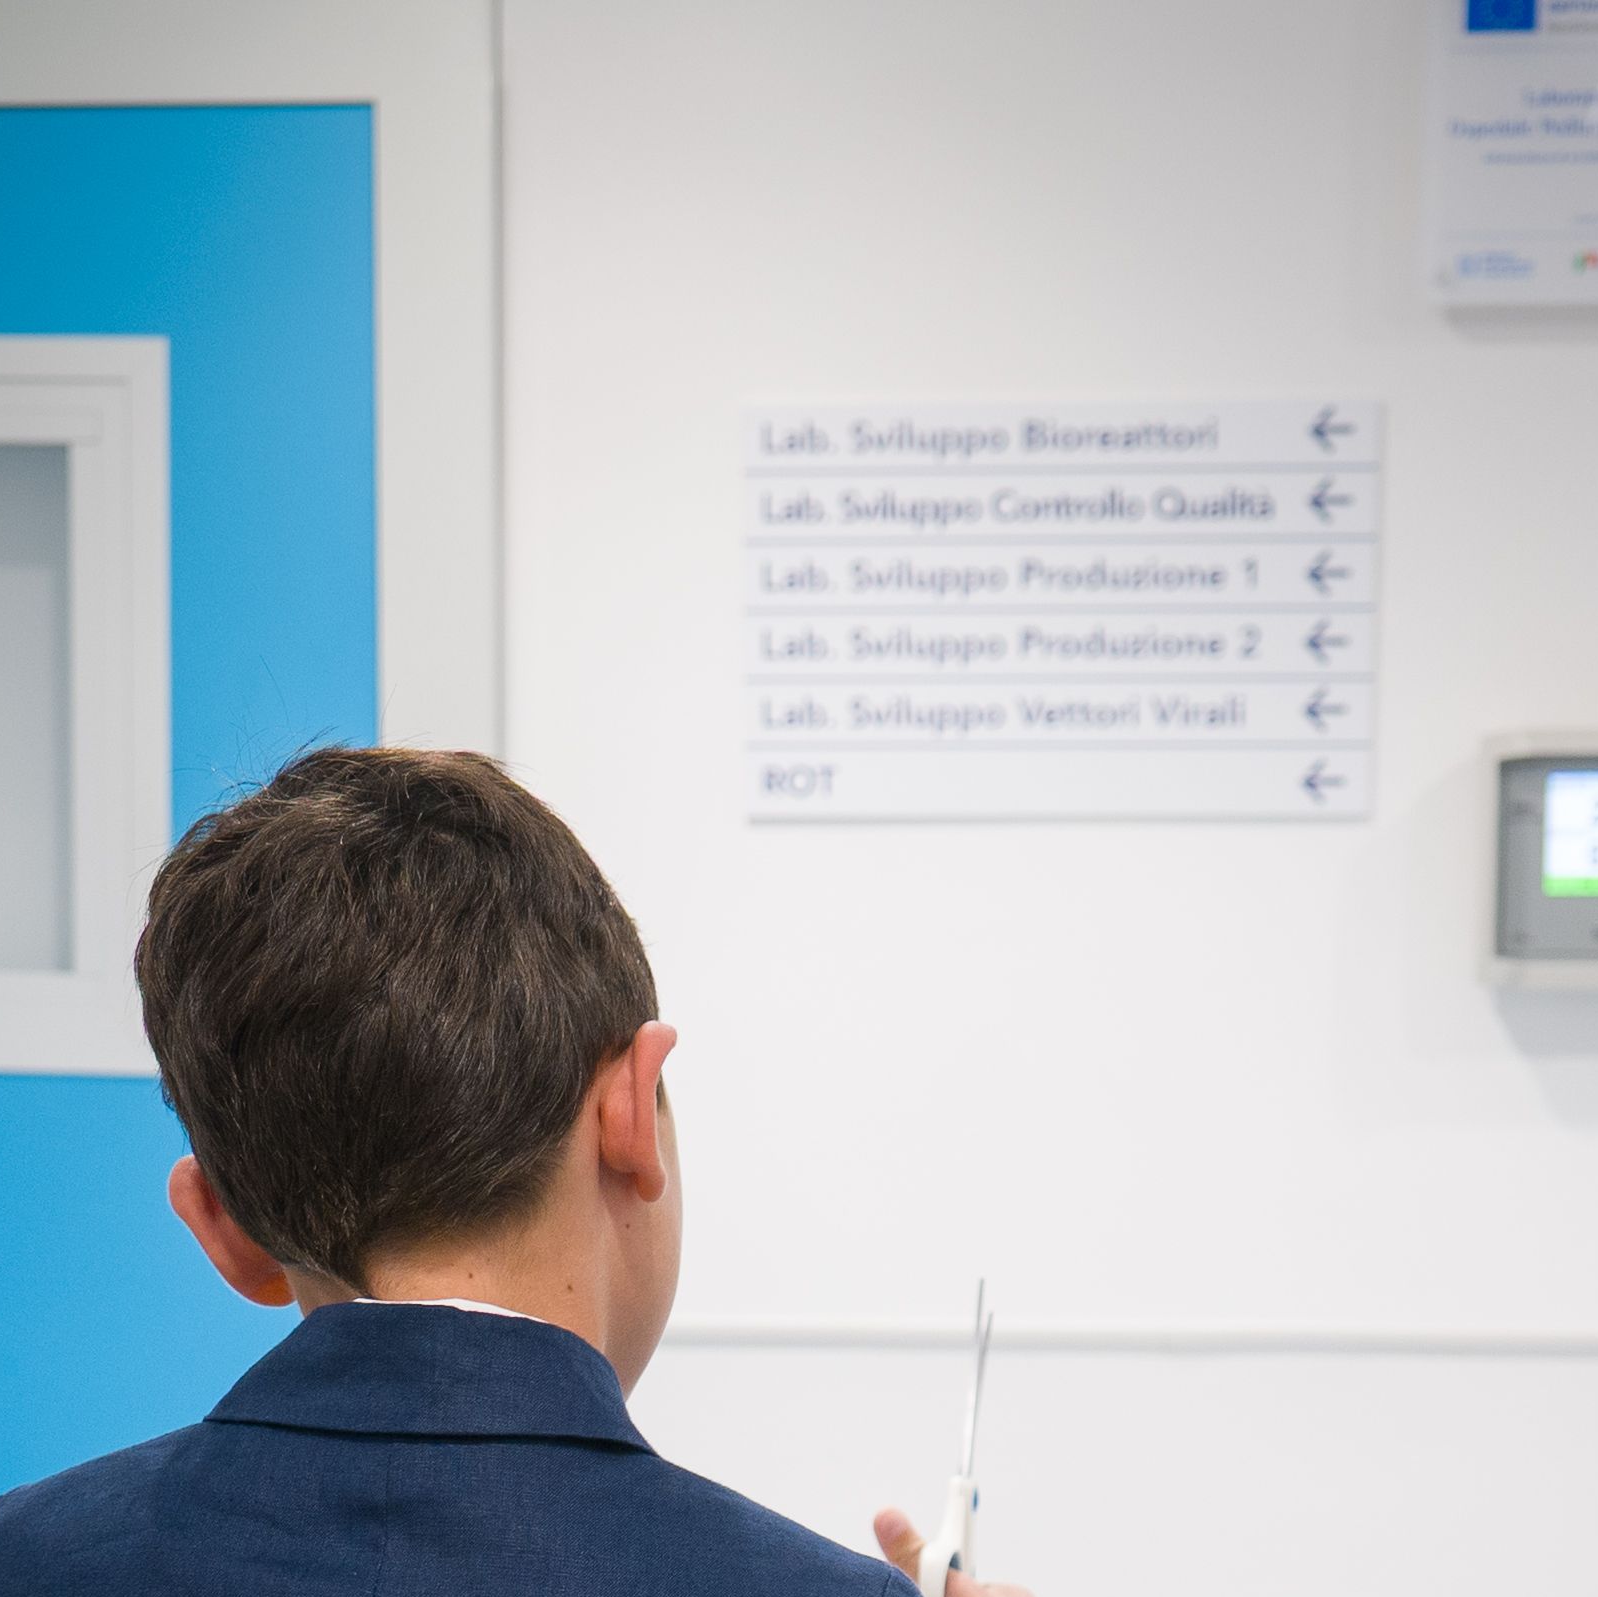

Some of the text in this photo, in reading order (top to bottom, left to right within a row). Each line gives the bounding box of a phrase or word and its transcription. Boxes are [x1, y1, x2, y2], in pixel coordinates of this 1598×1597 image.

[759, 417, 1221, 461] Lab. Sviluppo Bioreattori
[837, 487, 981, 531] Sviluppo
[988, 485, 1145, 523] Controllo
[1150, 485, 1277, 523] Qualità
[759, 554, 1262, 600] Lab. Sviluppo Produzione 1
[759, 623, 1263, 669] Lab. Sviluppo Produzione 2
[759, 691, 1247, 737] Lab. Sviluppo Vettori Virali
[759, 761, 840, 799] ROT
